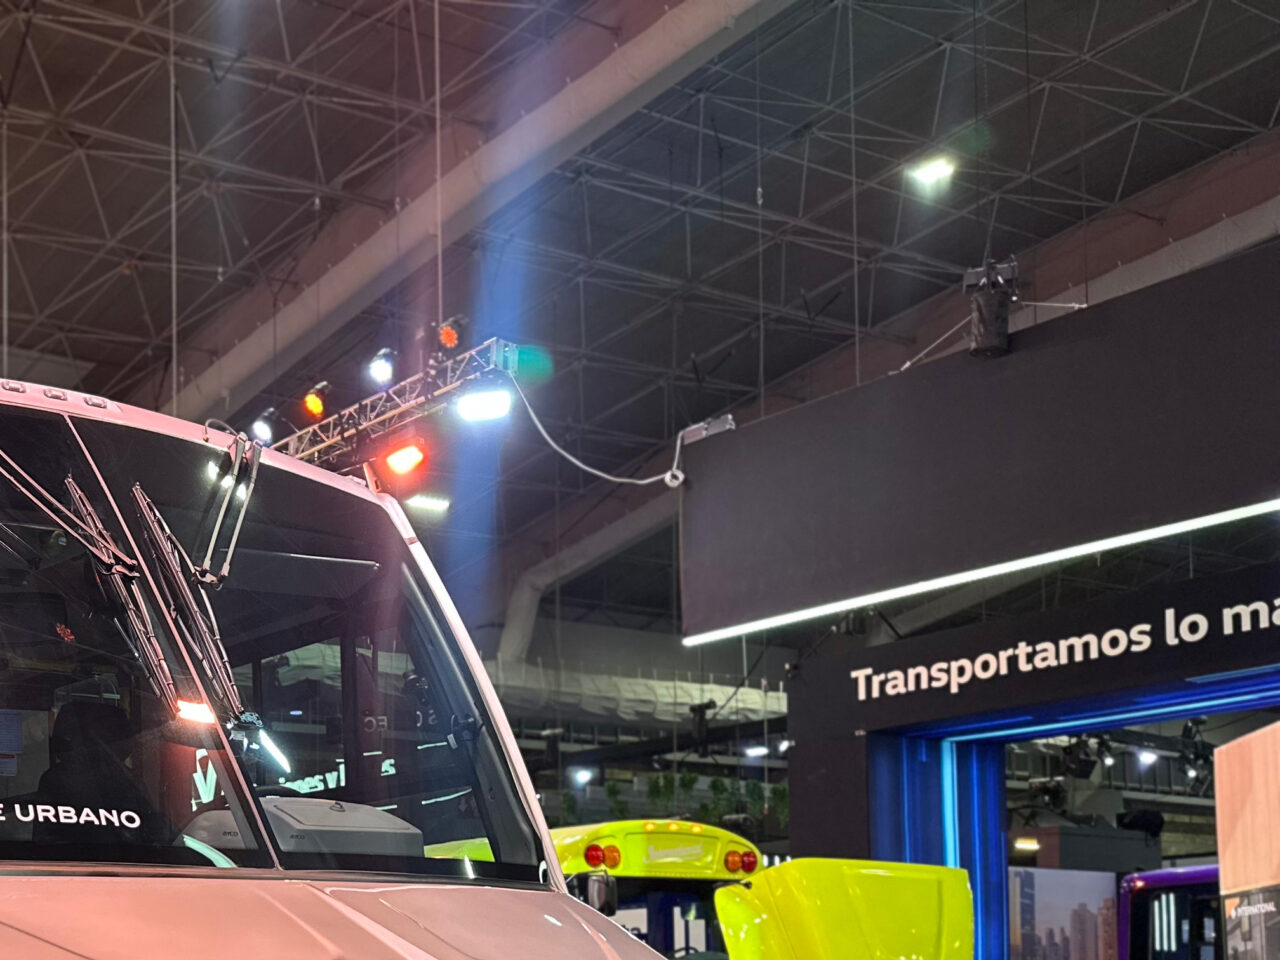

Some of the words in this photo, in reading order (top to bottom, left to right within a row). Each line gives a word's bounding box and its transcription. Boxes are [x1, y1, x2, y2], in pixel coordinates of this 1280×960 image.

[850, 623, 1152, 700] Transportamos
[1164, 608, 1208, 646] lo
[15, 803, 141, 828] URBANO
